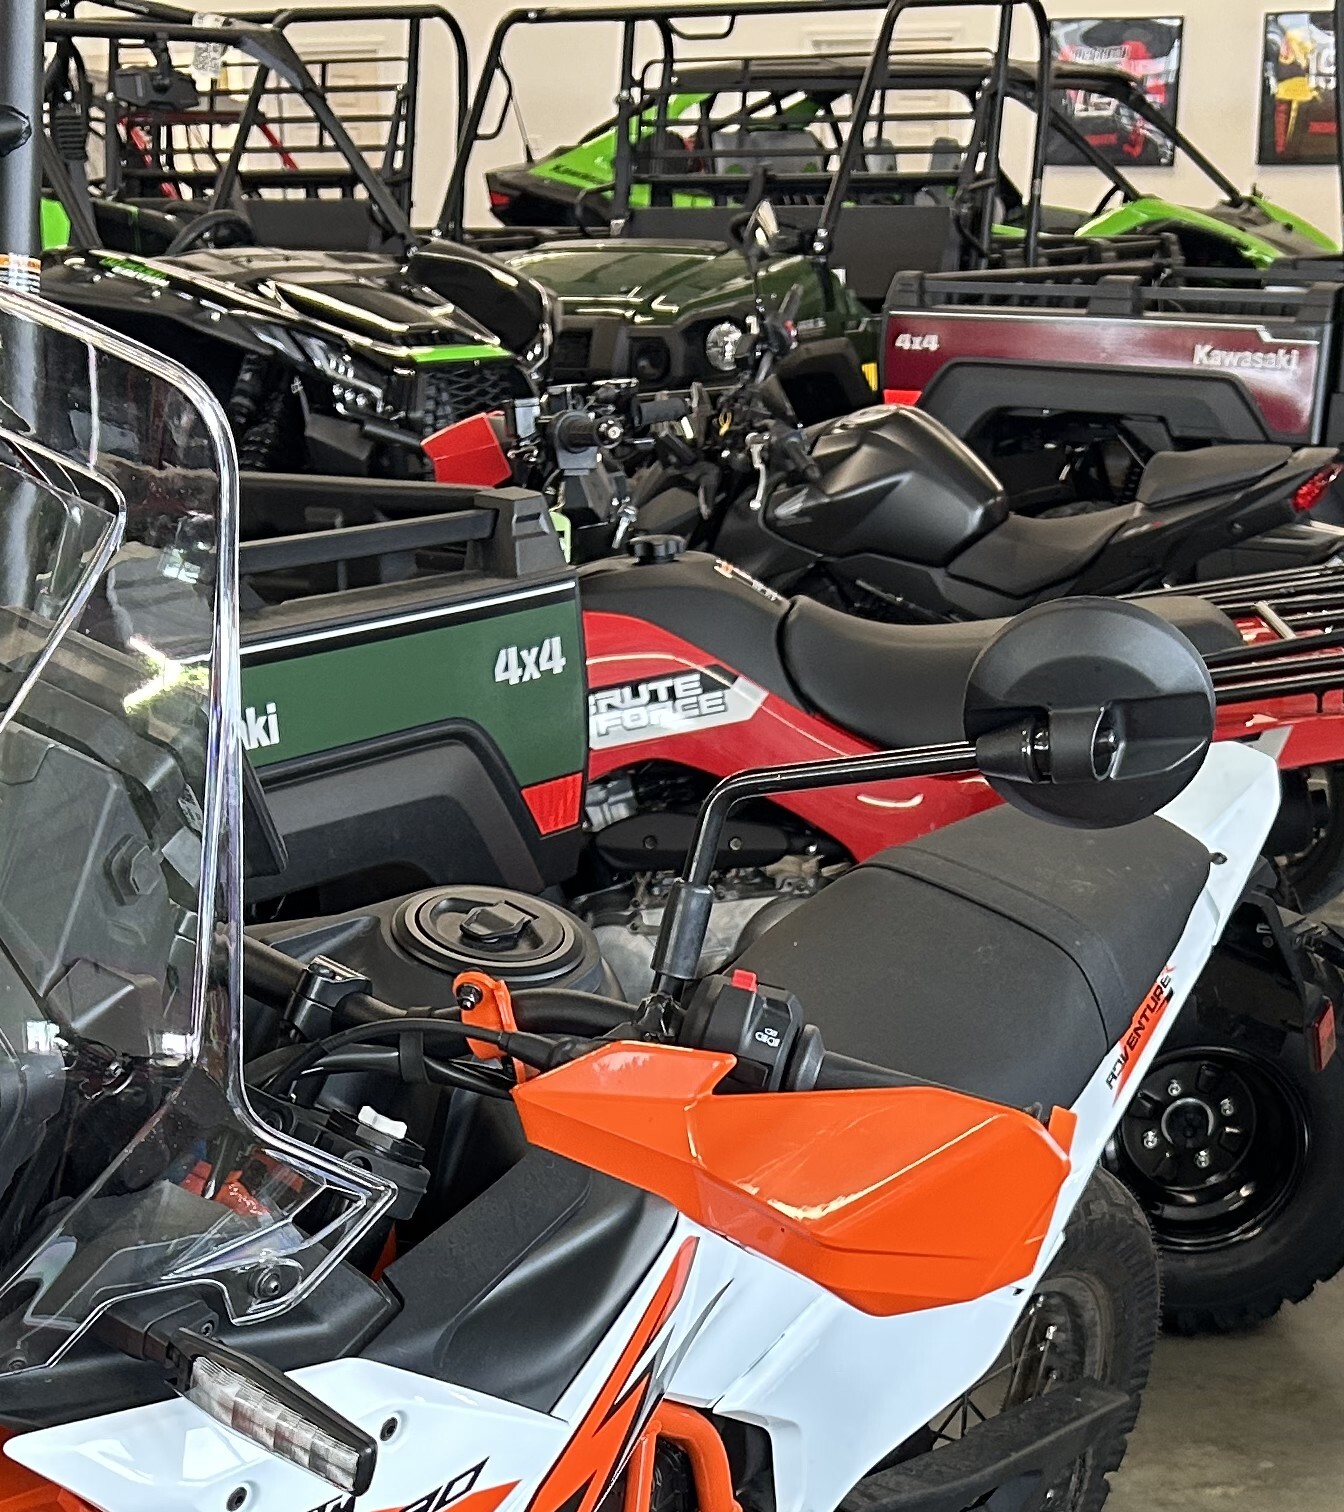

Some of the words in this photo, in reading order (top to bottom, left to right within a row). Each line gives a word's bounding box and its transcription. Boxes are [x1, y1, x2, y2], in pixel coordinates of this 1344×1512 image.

[895, 333, 940, 351] 4x4
[1192, 344, 1300, 369] Kawasaki
[494, 636, 567, 686] 4x4
[597, 691, 728, 737] FORCE
[1106, 975, 1172, 1091] ADVENTURE
